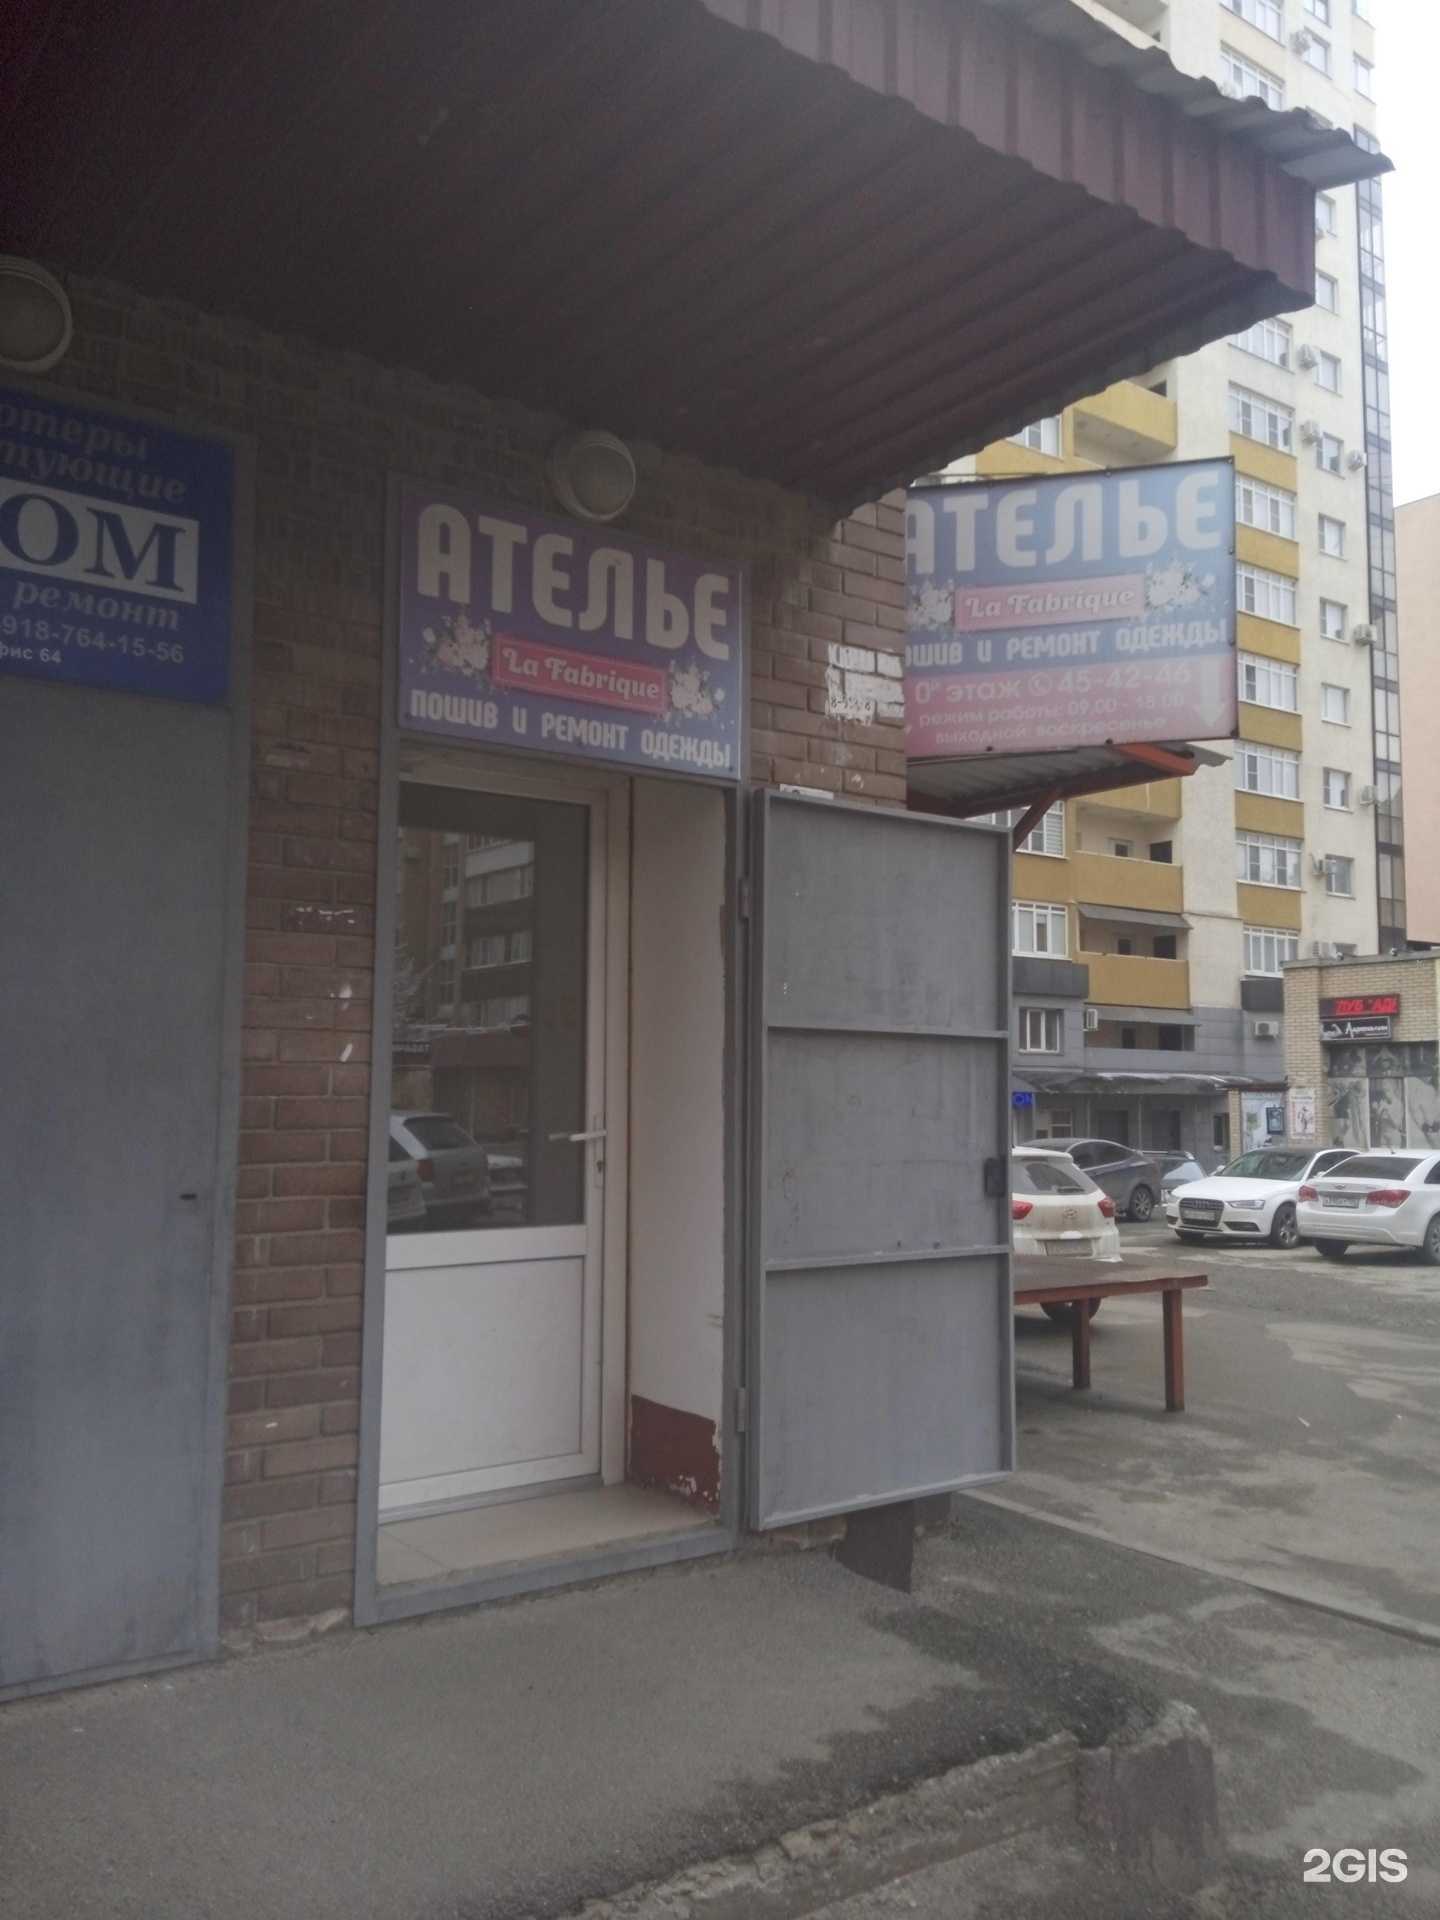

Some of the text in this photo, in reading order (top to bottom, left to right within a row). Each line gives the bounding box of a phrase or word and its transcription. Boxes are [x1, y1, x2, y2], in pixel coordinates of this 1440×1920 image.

[12, 580, 180, 631] ремонт
[416, 502, 730, 661] АТЕЛЬЕ
[965, 588, 1137, 619] La Fabrique
[0, 614, 185, 665] 918-764-15-56
[39, 647, 62, 664] 64
[1006, 630, 1101, 661] РЕМОНТ
[1115, 619, 1227, 653] ОДЕЖДЫ
[502, 647, 660, 701] La Fabrique
[946, 679, 1022, 704] этаж
[411, 688, 499, 730] ПОШИВ
[541, 712, 630, 751] РЕМОНТ
[640, 729, 731, 769] ОДЕЖДЫ
